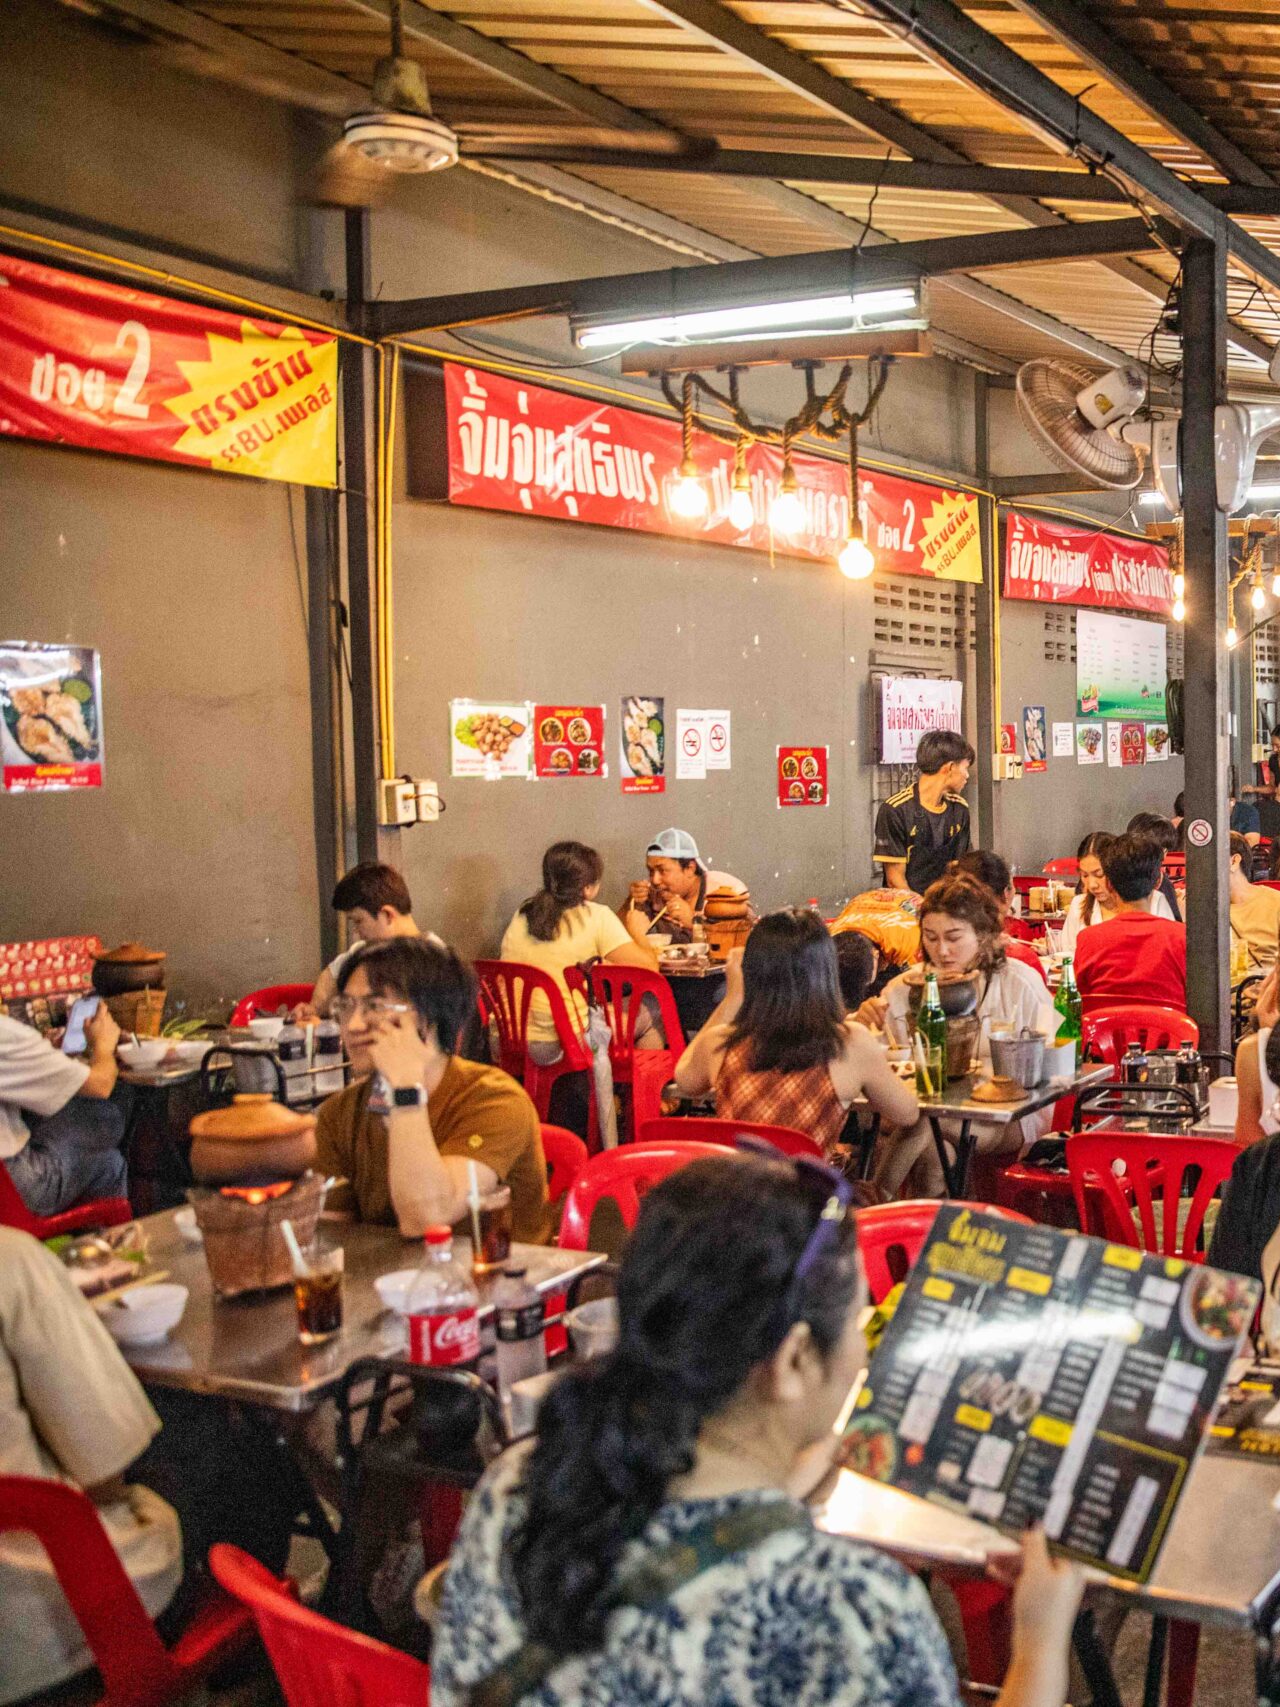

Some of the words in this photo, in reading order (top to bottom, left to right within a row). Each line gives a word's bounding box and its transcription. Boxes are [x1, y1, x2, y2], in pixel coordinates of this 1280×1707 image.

[112, 320, 151, 420] 2
[190, 349, 313, 436] ตรงข้าม
[902, 498, 916, 553] 2
[925, 506, 969, 559] ตรงข้าม
